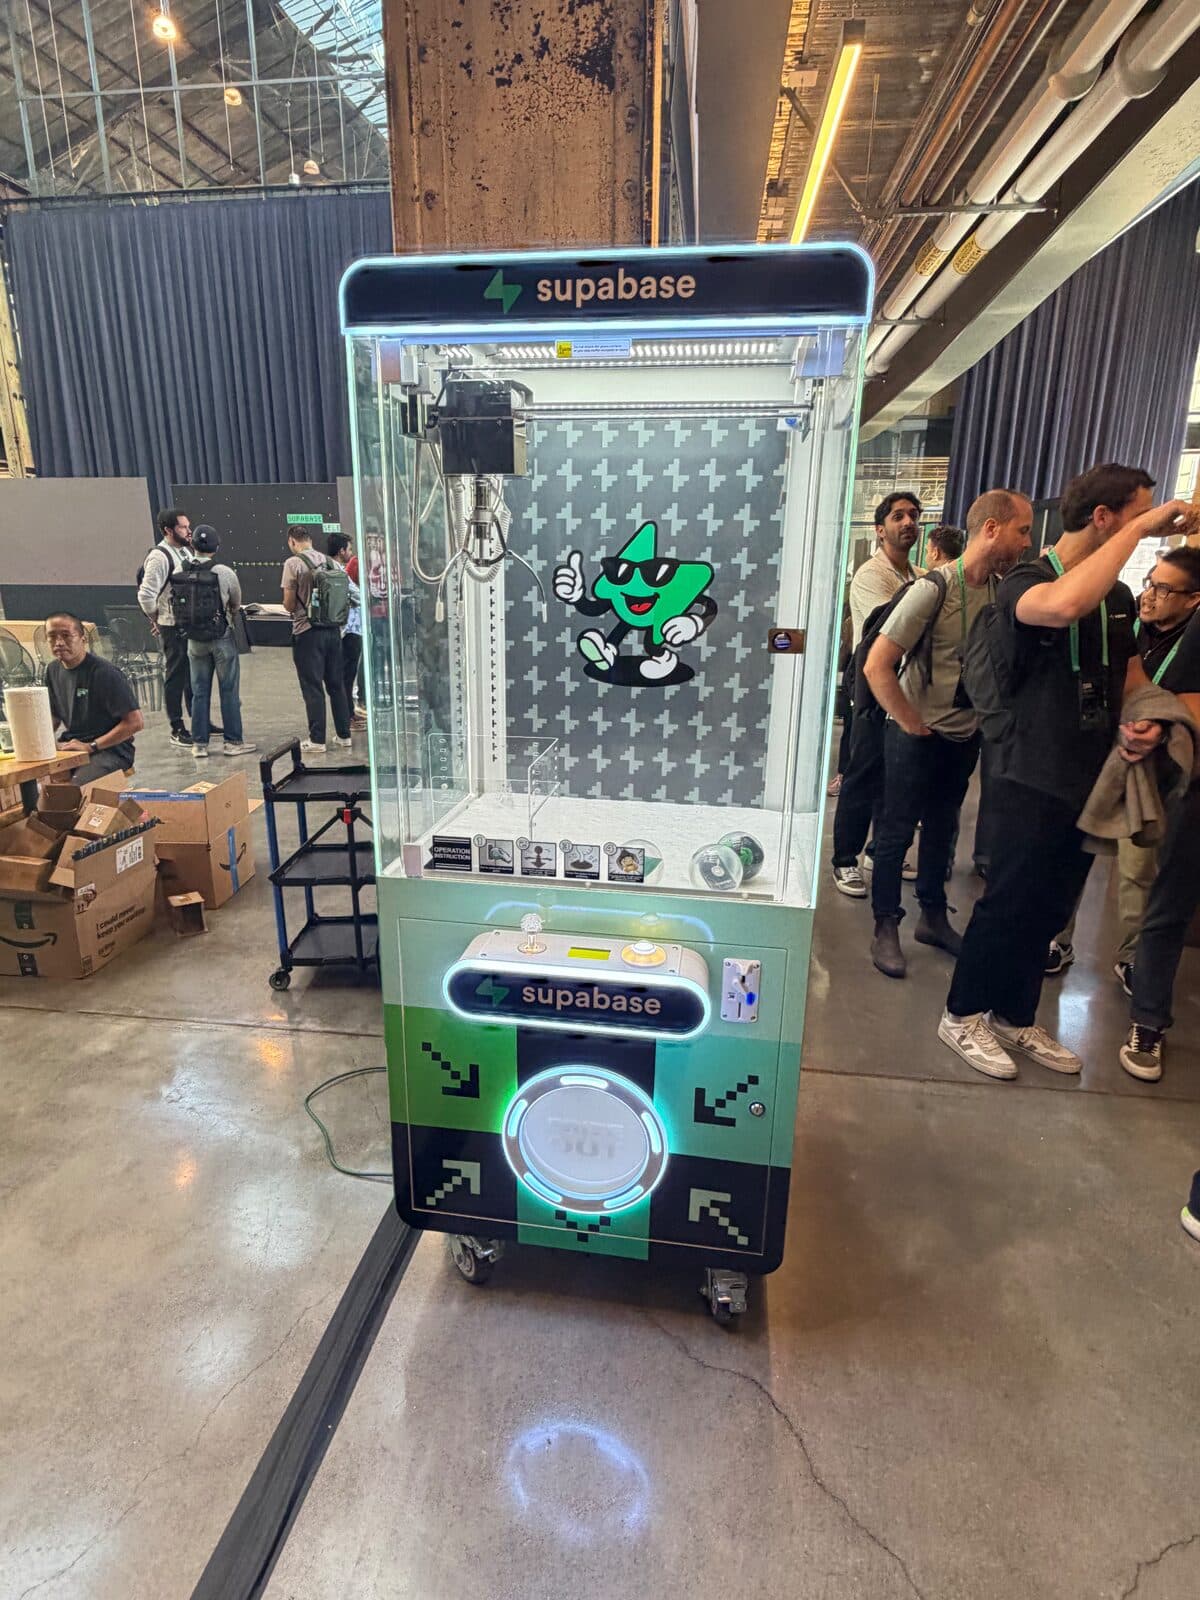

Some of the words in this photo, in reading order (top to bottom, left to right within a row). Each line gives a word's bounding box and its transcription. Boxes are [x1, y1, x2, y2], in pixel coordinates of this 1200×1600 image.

[537, 268, 696, 308] supabase
[433, 846, 471, 854] OPERATION
[522, 986, 661, 1015] supabase
